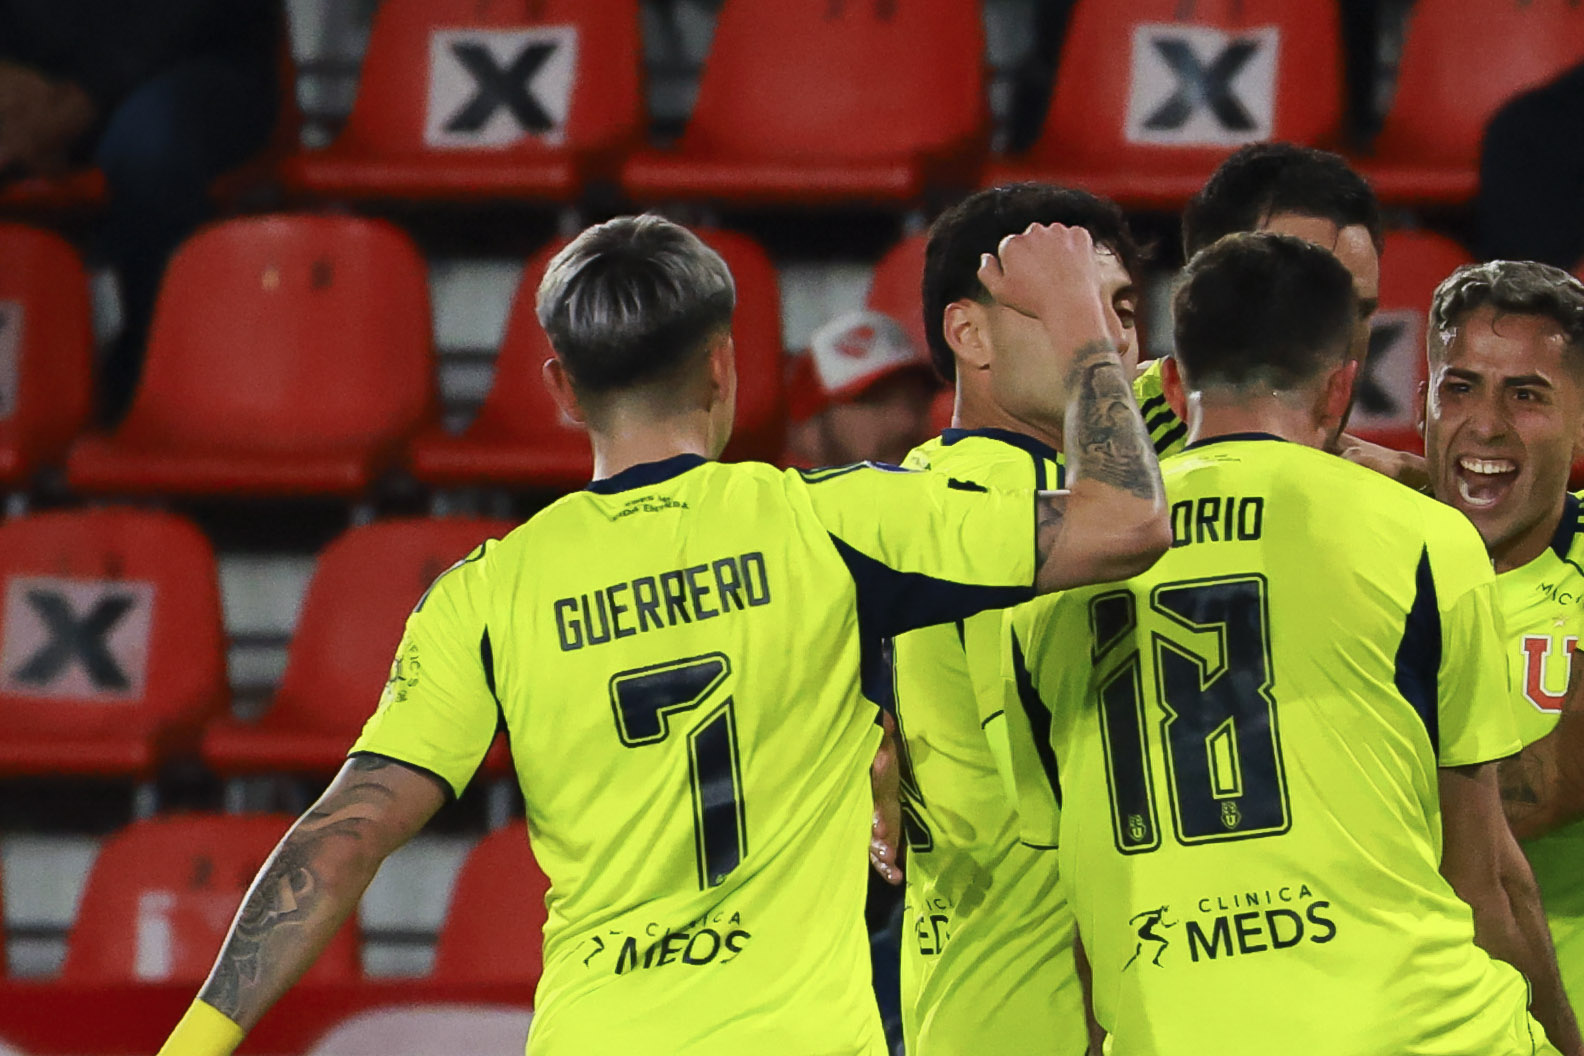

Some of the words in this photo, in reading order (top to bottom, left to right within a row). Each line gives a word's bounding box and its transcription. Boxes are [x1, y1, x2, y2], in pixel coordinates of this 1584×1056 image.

[1170, 497, 1265, 549] ORIO
[553, 551, 771, 652] GUERRERO
[1521, 634, 1579, 714] U
[1089, 573, 1292, 856] 18
[609, 651, 748, 891] 7
[1185, 901, 1337, 963] MEDS
[1198, 884, 1313, 913] CLINICA
